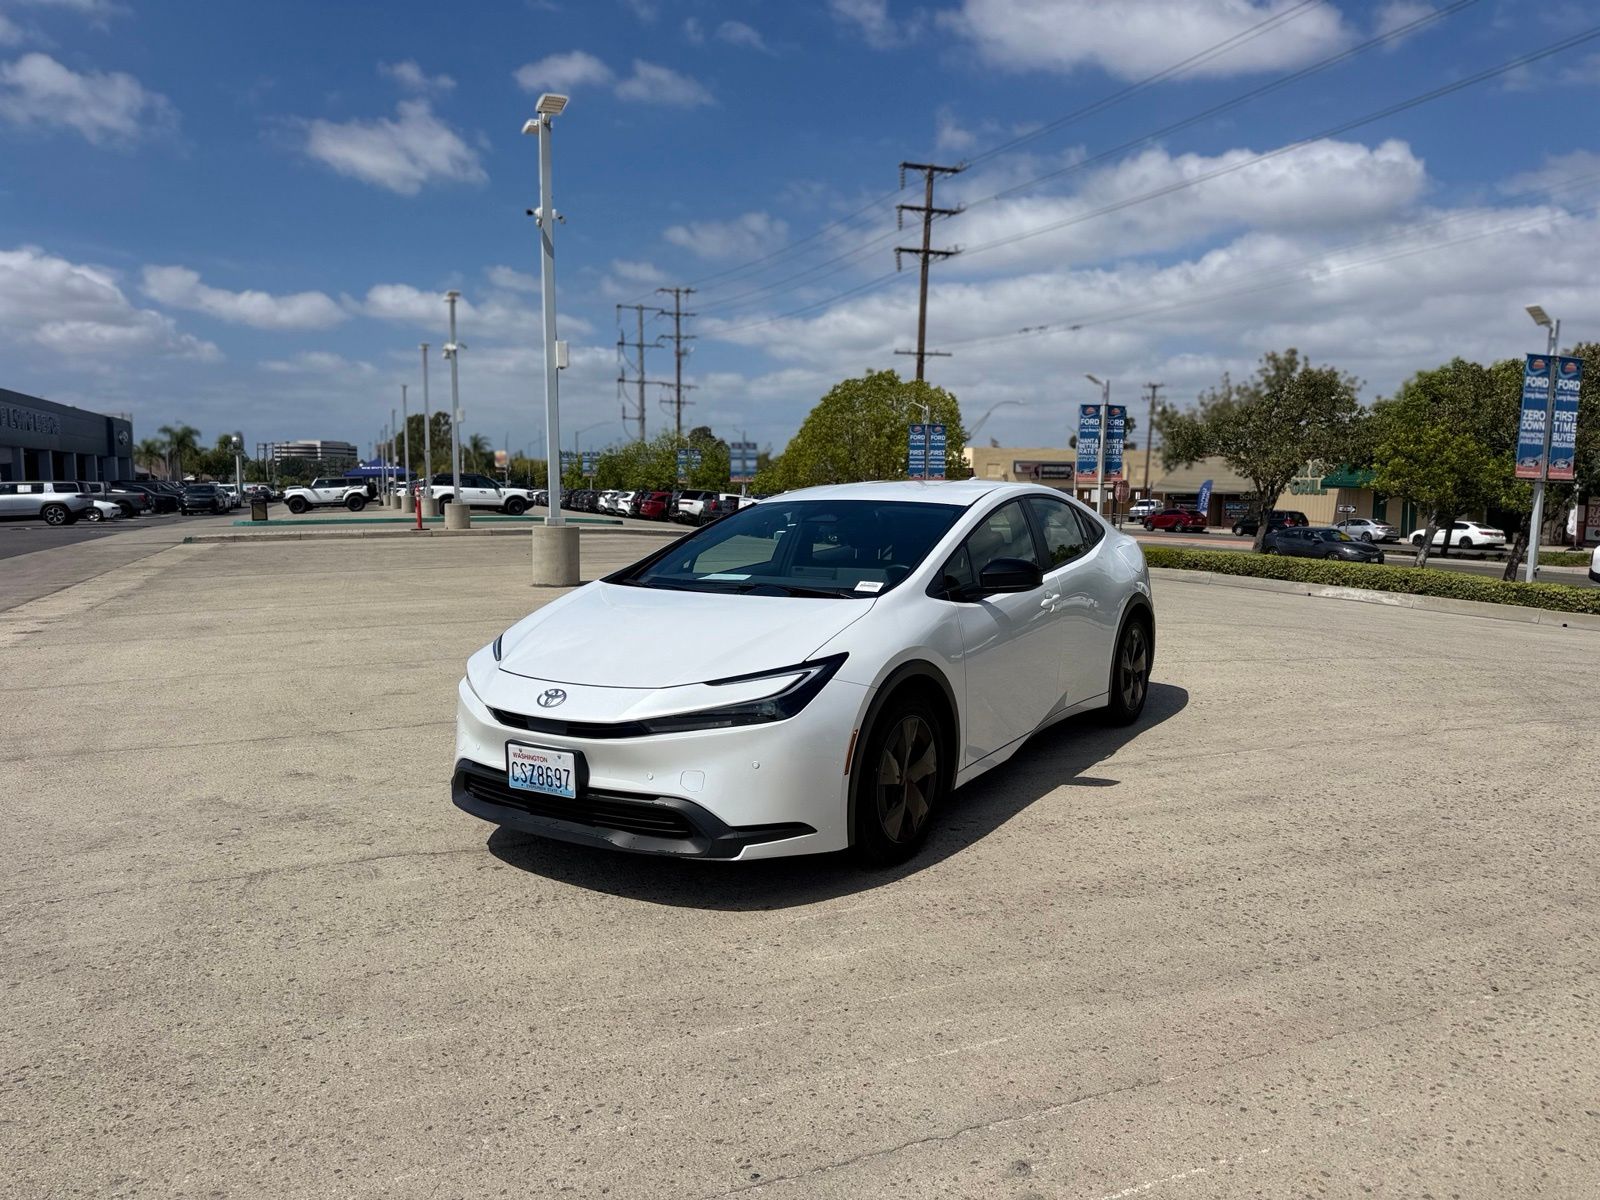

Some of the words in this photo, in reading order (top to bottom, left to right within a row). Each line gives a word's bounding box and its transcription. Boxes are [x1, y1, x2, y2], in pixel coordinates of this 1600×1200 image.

[1525, 377, 1550, 388] FORD
[1558, 380, 1580, 390] FORD
[1522, 410, 1546, 420] ZERO
[1554, 411, 1578, 421] FIRST
[1522, 422, 1546, 430] DOWN
[1553, 422, 1577, 432] TIME
[1552, 433, 1576, 442] BUYER
[512, 752, 548, 762] WASHINGTON
[511, 761, 571, 791] CSZ8697
